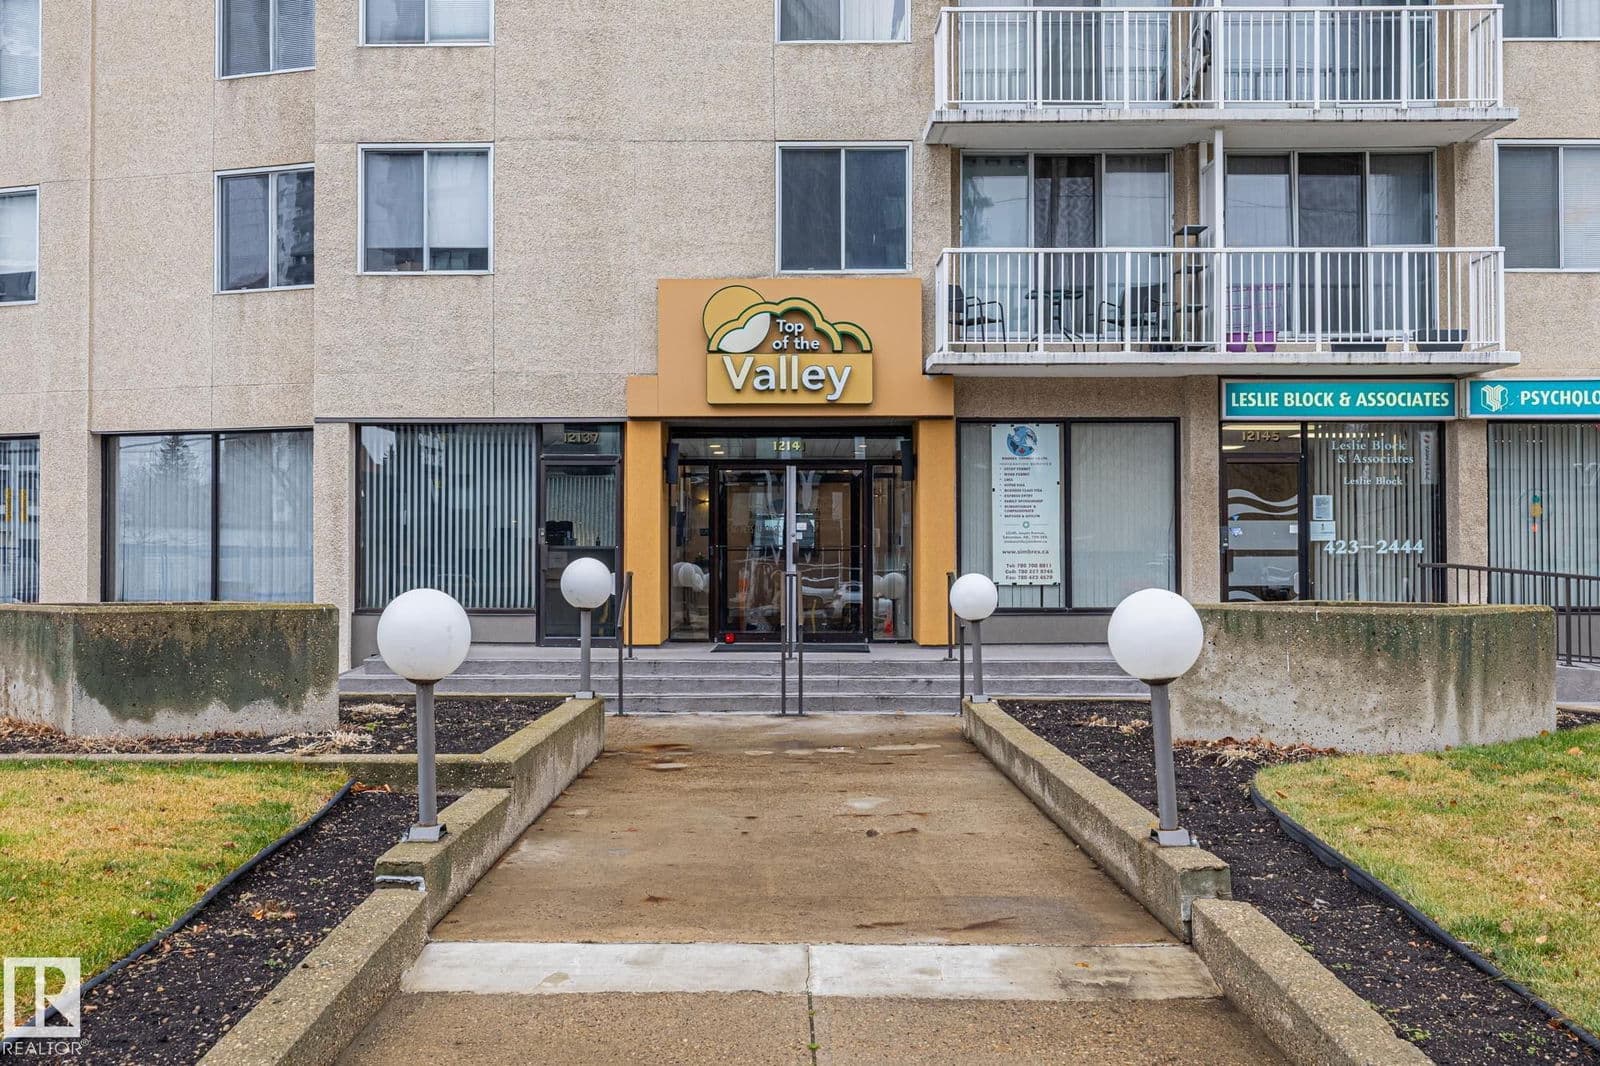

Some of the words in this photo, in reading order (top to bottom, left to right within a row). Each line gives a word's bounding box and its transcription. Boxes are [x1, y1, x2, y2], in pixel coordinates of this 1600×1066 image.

[776, 319, 805, 335] Top
[772, 336, 789, 350] of
[793, 337, 820, 350] the
[722, 355, 852, 401] Valley
[1231, 392, 1279, 407] LESLIE
[1284, 392, 1334, 407] BLOCK
[1339, 392, 1351, 407] &
[1356, 392, 1449, 407] ASSOCIATES
[1242, 431, 1280, 442] 12145
[1331, 440, 1366, 450] Leslie
[1372, 440, 1407, 450] Block
[1353, 454, 1414, 464] Associates
[1343, 476, 1372, 485] Leslie
[1376, 476, 1403, 485] Block
